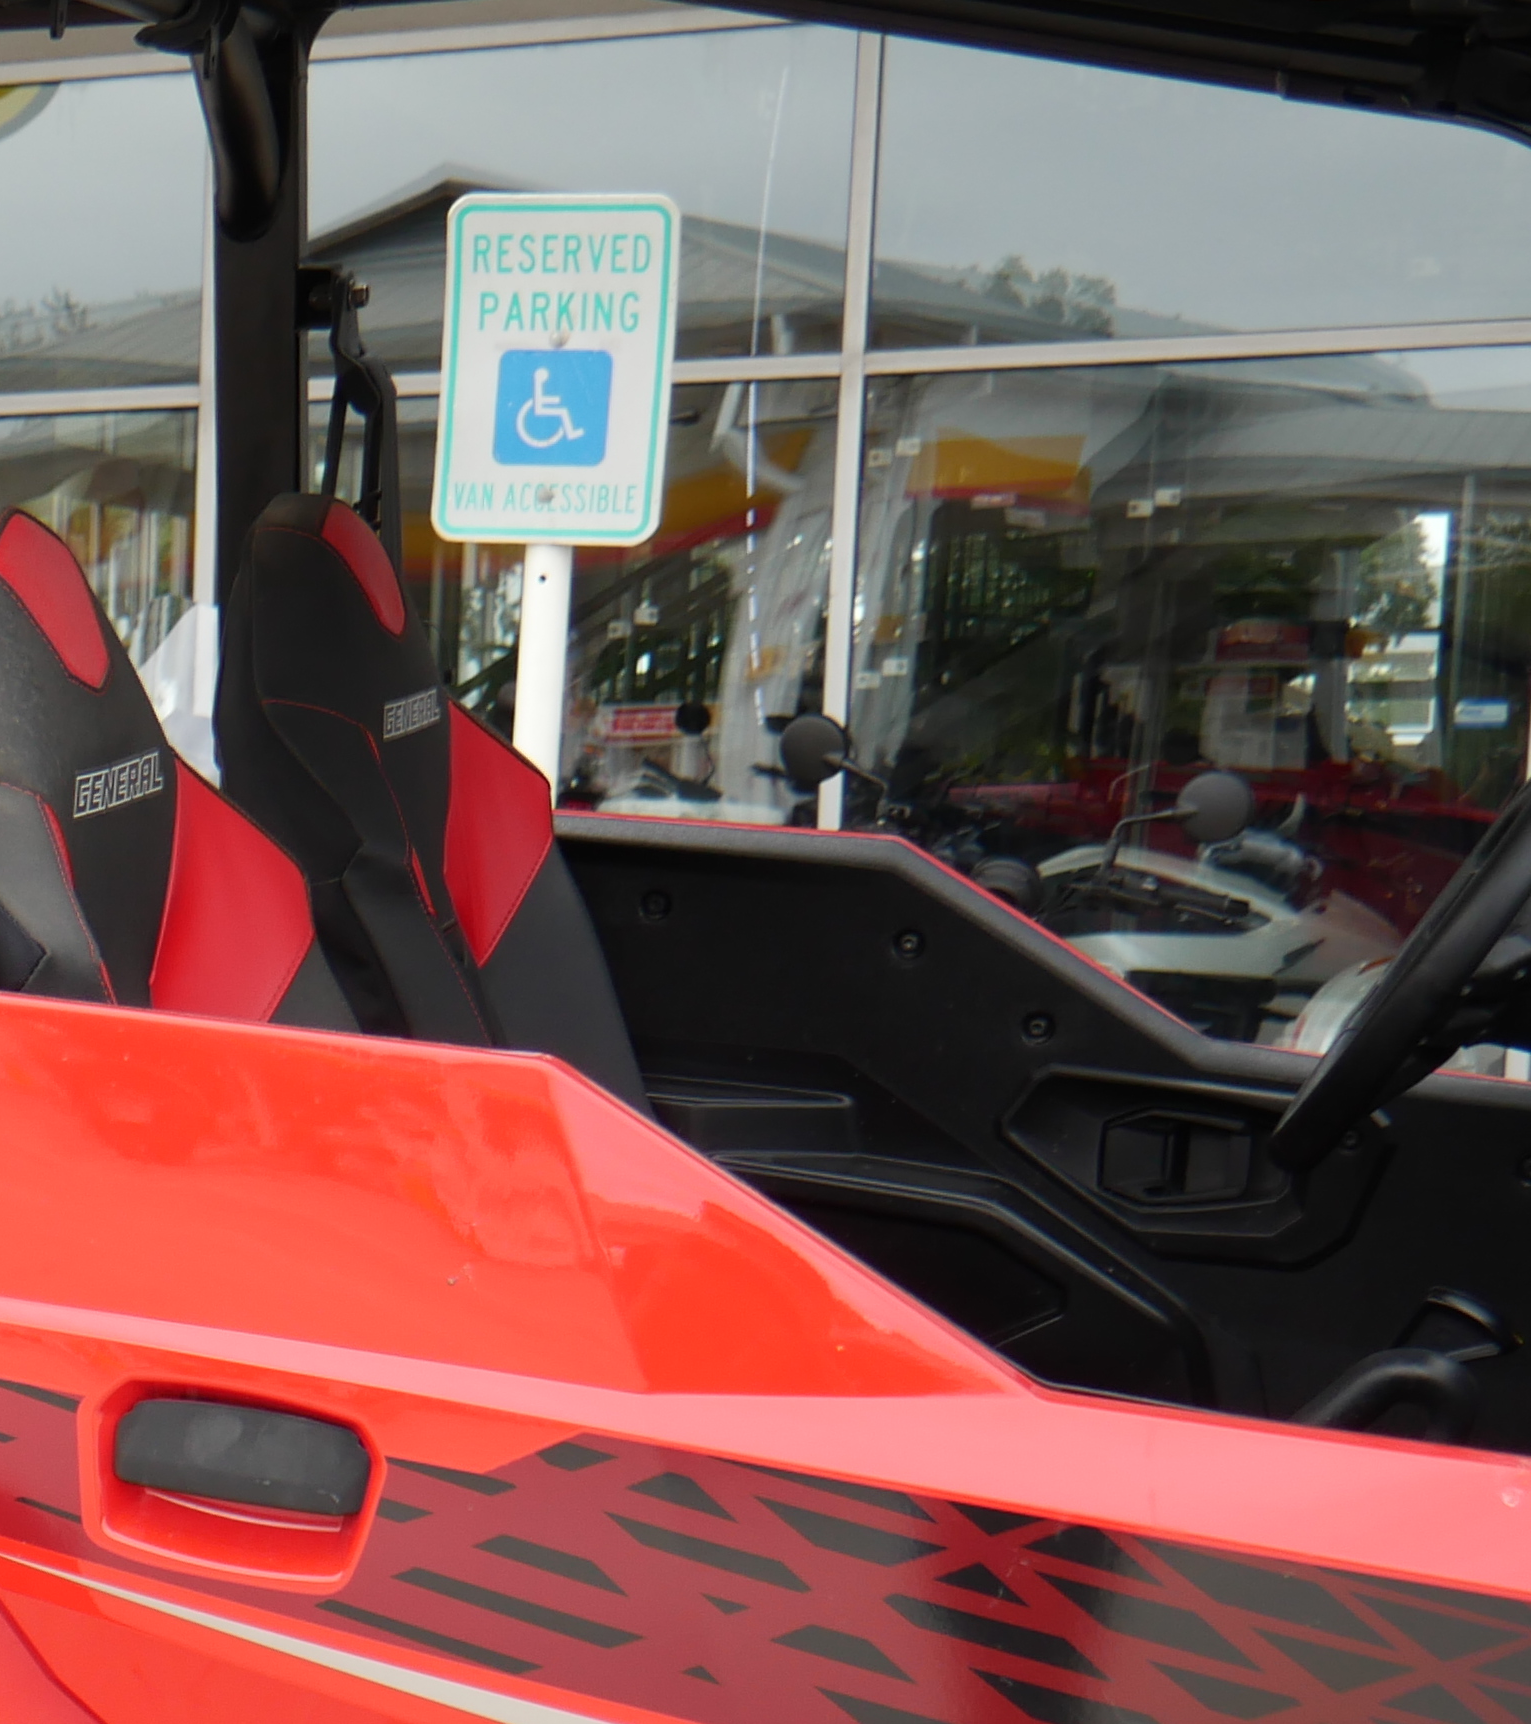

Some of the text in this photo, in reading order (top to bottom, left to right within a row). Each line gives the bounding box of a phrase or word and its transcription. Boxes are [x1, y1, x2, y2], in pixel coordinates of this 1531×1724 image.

[472, 233, 651, 274] RESERVED
[478, 291, 640, 333] PARKING
[453, 482, 638, 514] VAN ACCESSIBLE
[73, 751, 164, 819] GENERAL
